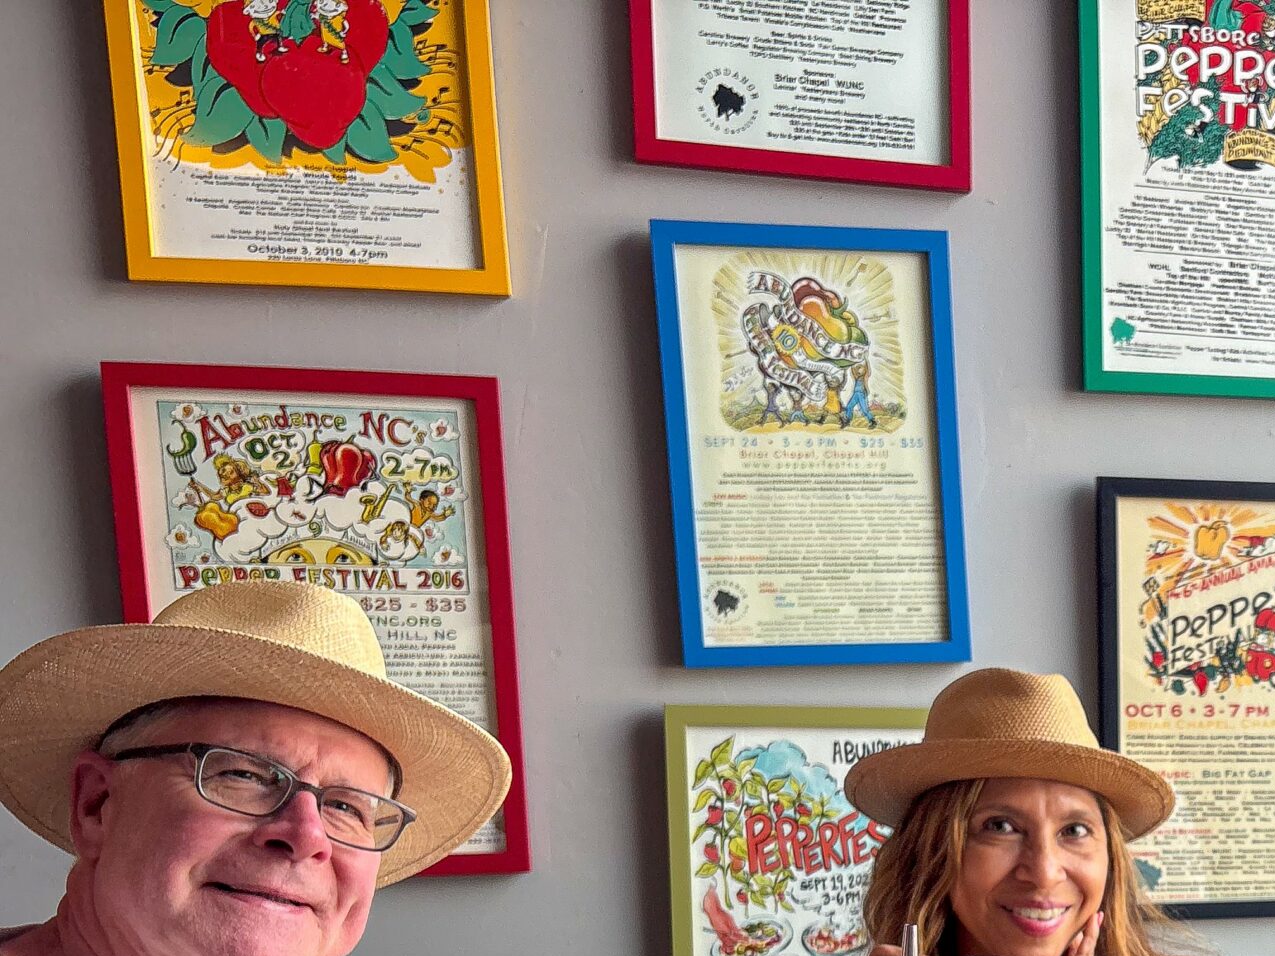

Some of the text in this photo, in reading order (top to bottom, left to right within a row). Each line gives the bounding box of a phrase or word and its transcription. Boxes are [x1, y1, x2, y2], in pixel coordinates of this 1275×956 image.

[247, 244, 298, 255] October
[314, 246, 343, 257] 2010
[195, 405, 427, 463] Abundance NC's
[274, 450, 295, 471] 2
[415, 569, 465, 590] 2016
[360, 596, 467, 613] $25 $35
[387, 629, 457, 641] HILL, NC
[1125, 704, 1166, 717] OCT
[1170, 704, 1182, 717] 6
[1245, 706, 1270, 717] PM
[1225, 770, 1246, 778] FAT
[1247, 770, 1272, 778] GAP
[745, 811, 889, 877] PEPPERFES
[849, 873, 869, 889] 202
